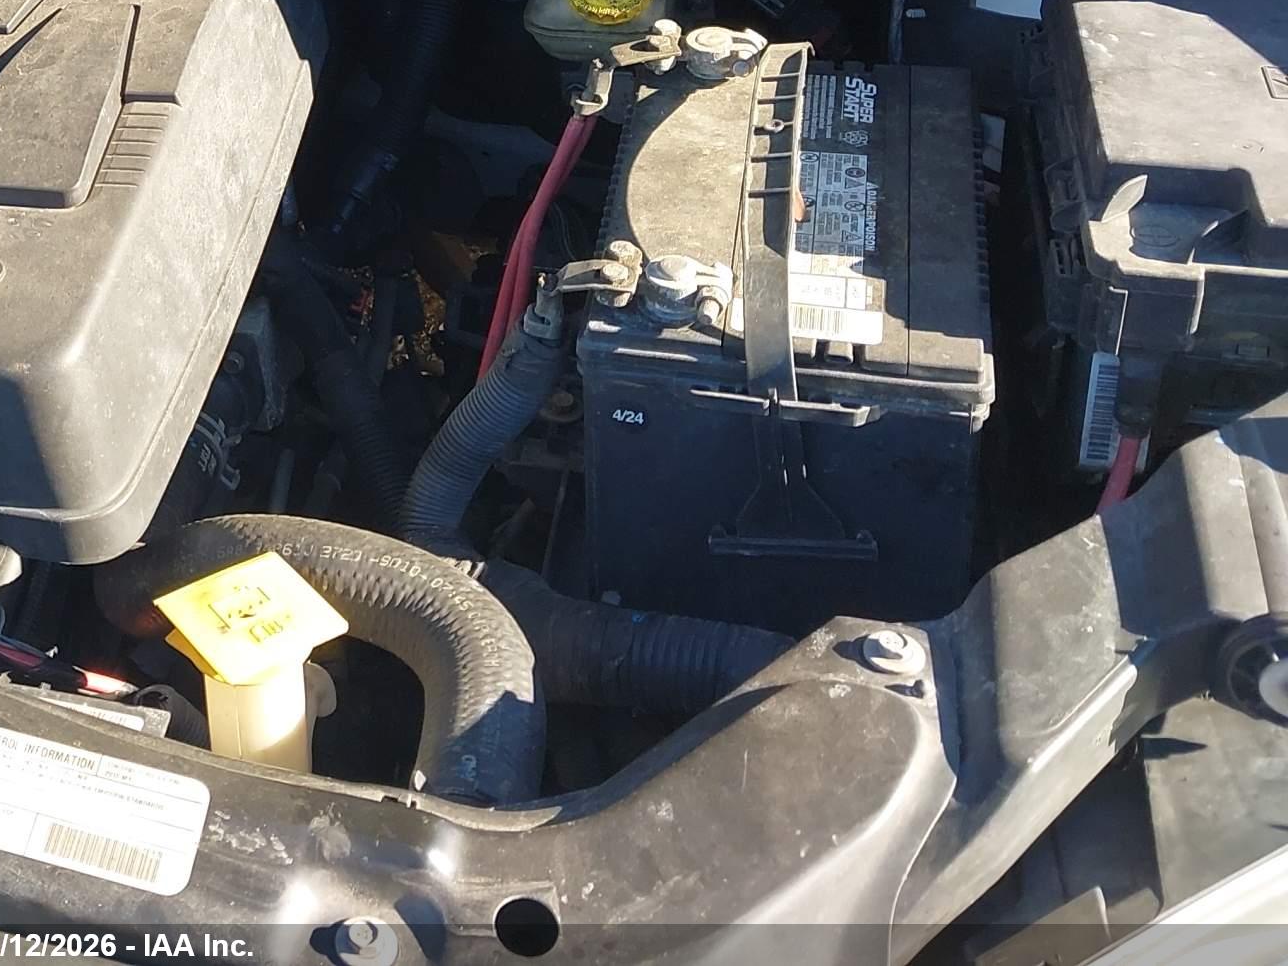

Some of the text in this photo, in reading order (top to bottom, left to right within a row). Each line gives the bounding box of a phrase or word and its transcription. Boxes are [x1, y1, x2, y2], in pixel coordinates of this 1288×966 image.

[843, 75, 863, 123] START
[860, 82, 877, 124] SUPER
[611, 409, 644, 425] 4/24
[23, 741, 96, 771] INFORMATION
